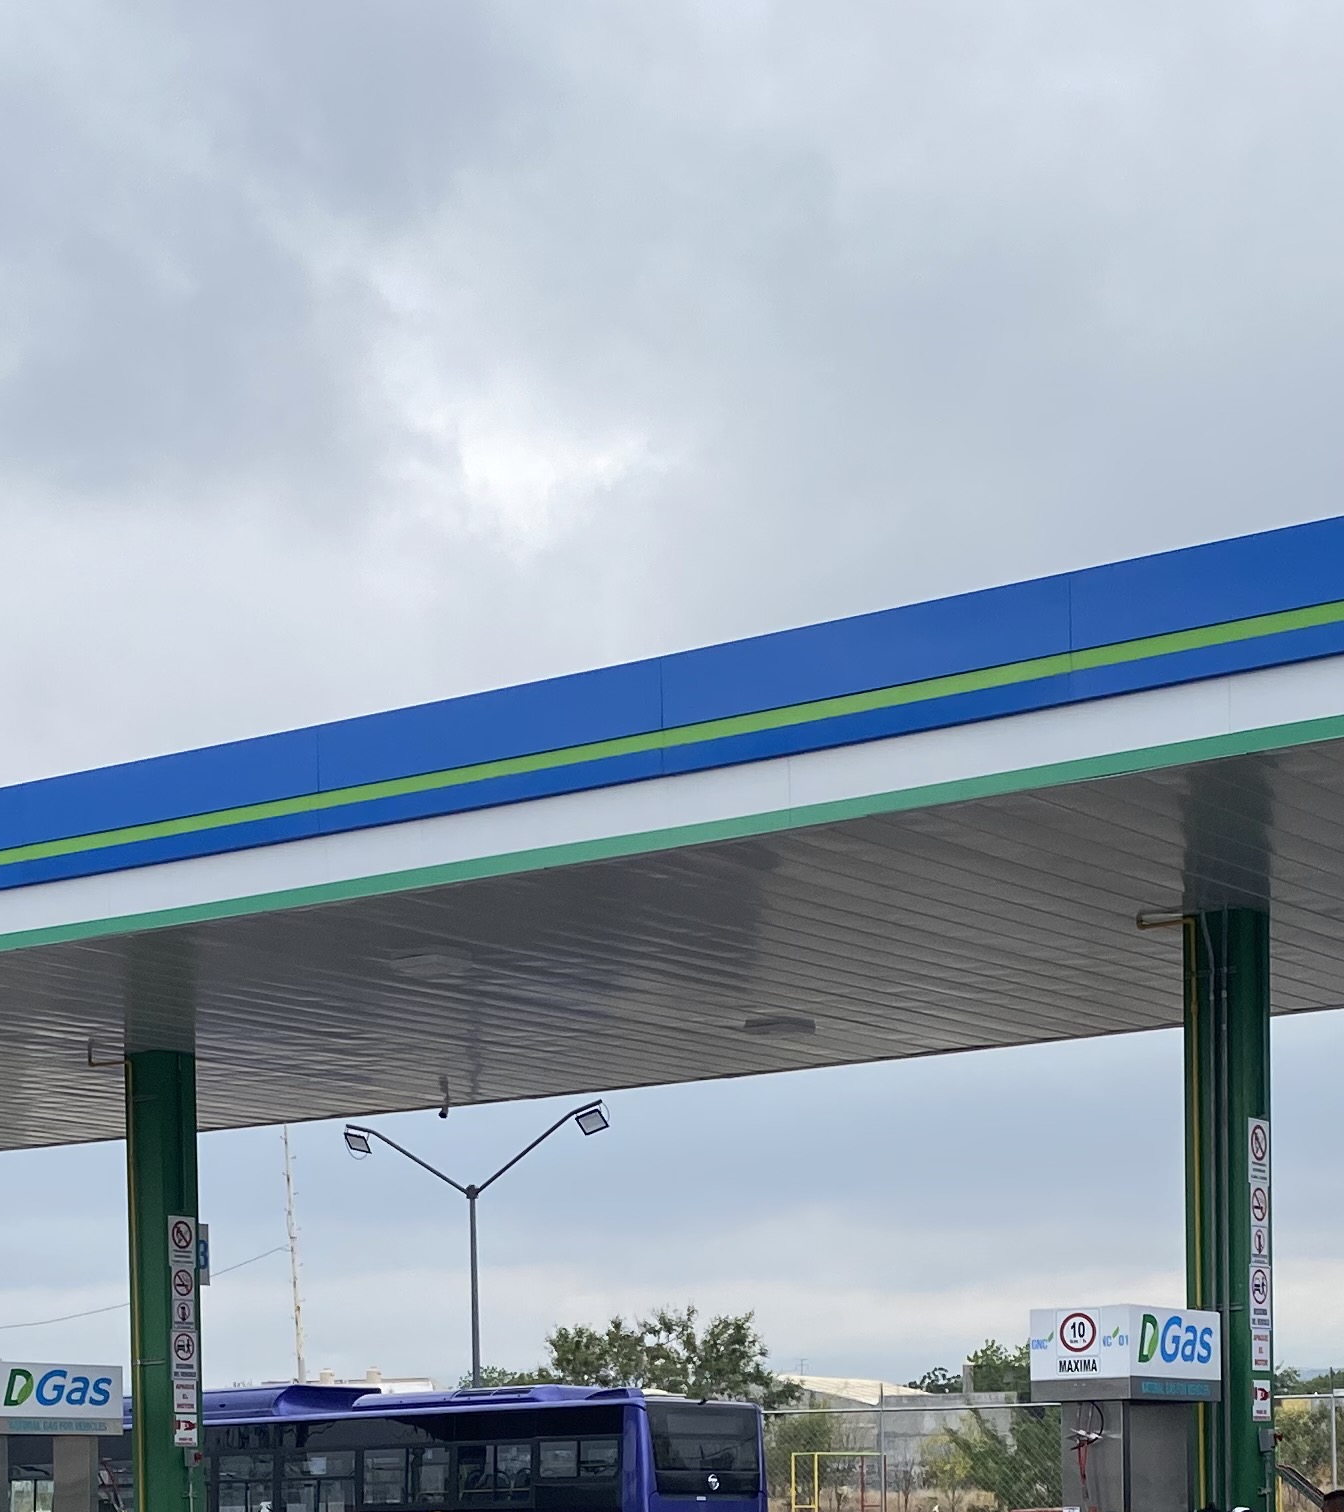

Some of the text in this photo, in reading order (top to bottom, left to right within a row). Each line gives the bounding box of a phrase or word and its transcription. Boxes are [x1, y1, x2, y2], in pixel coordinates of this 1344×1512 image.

[1070, 1321, 1086, 1339] 10
[1138, 1313, 1213, 1364] DGas
[1118, 1334, 1129, 1346] 01
[1059, 1359, 1098, 1373] MAXIMA
[4, 1368, 113, 1407] DGas
